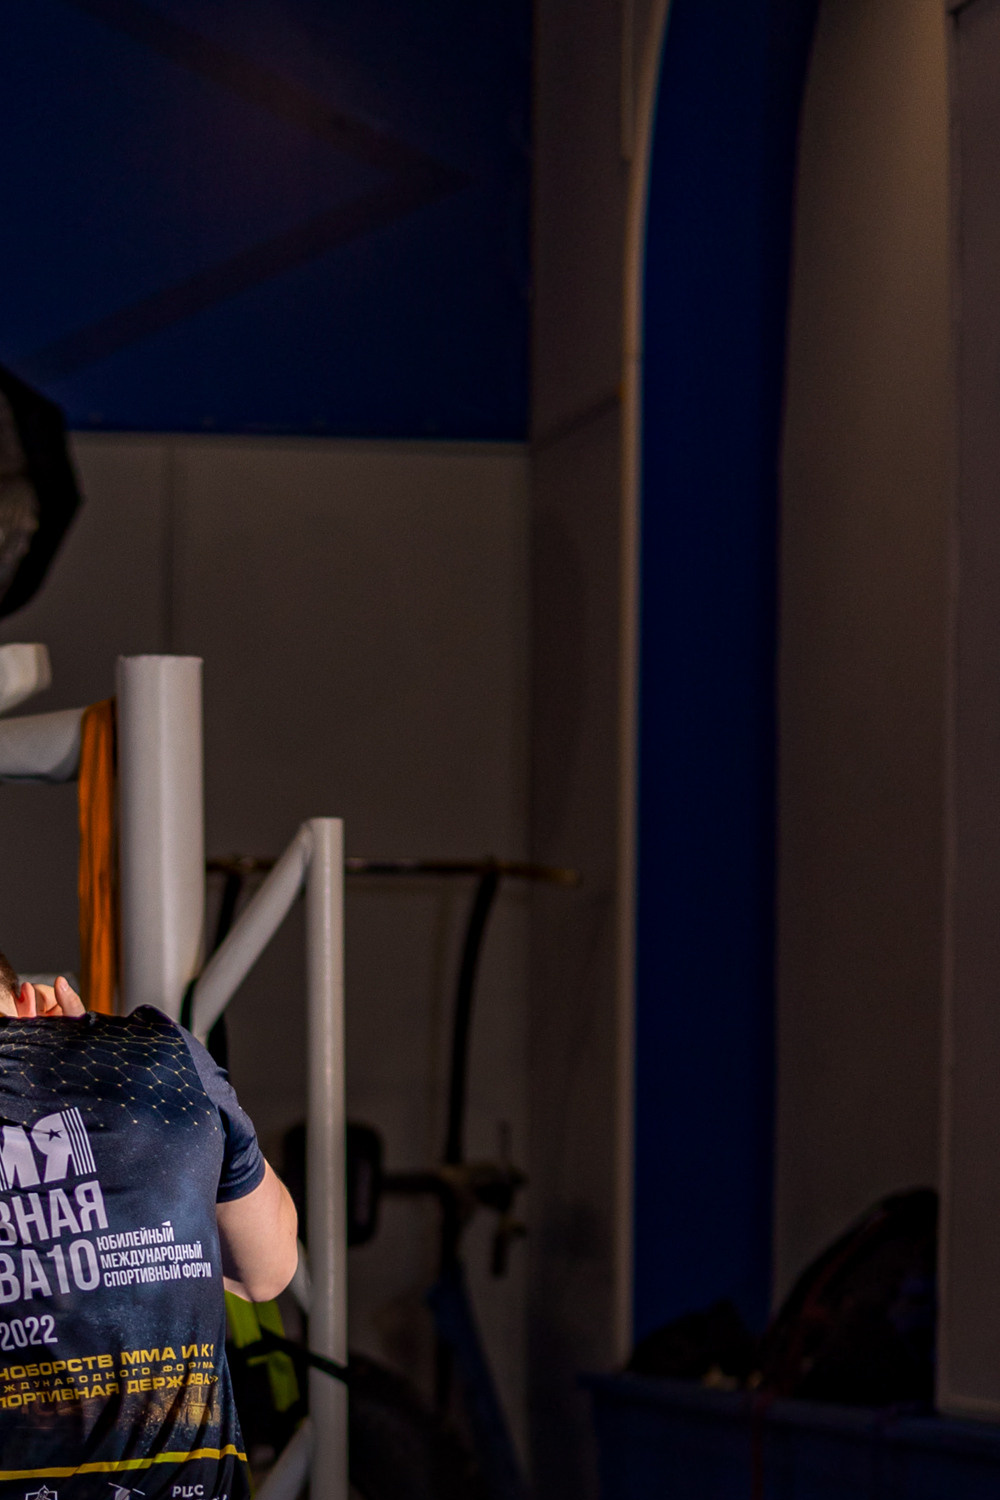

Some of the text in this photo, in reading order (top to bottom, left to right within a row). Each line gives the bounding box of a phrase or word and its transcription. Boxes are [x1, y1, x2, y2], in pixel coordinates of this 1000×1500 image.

[96, 1220, 175, 1252] ЮБИЛЕЙНЫЙ
[100, 1240, 204, 1269] МЕЖДУНАРОДНЫЙ
[103, 1262, 213, 1288] СПОРТИВНЫЙ ФОРУМ
[120, 1346, 177, 1365] ММА
